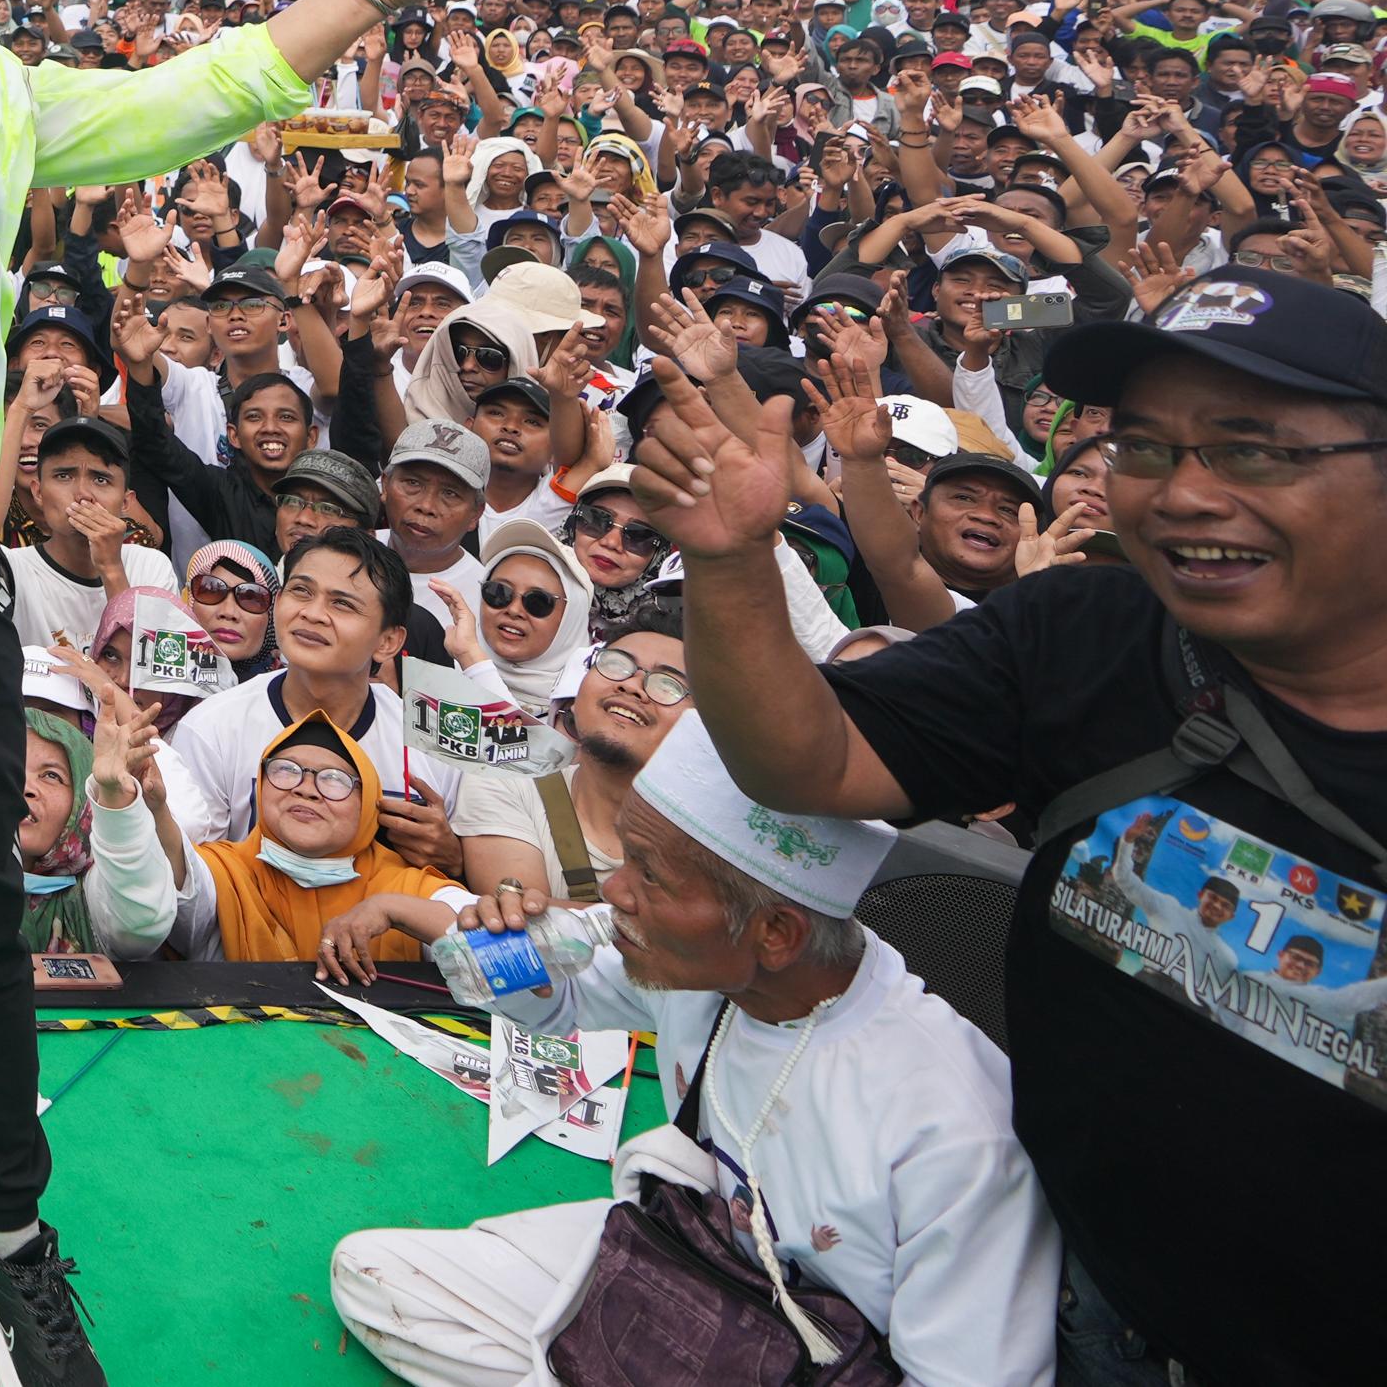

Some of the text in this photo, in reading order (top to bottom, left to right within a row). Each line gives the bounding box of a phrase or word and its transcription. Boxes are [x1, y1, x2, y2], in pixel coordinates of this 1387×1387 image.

[136, 634, 148, 667] 1
[152, 664, 187, 678] PKB
[413, 698, 431, 734] 1
[438, 736, 478, 758] PKB
[1225, 864, 1259, 885] PKB
[1280, 887, 1317, 911] PKS
[1247, 899, 1286, 954] 1
[1050, 881, 1378, 1078] SILATURAHMI AMIN TEGAL
